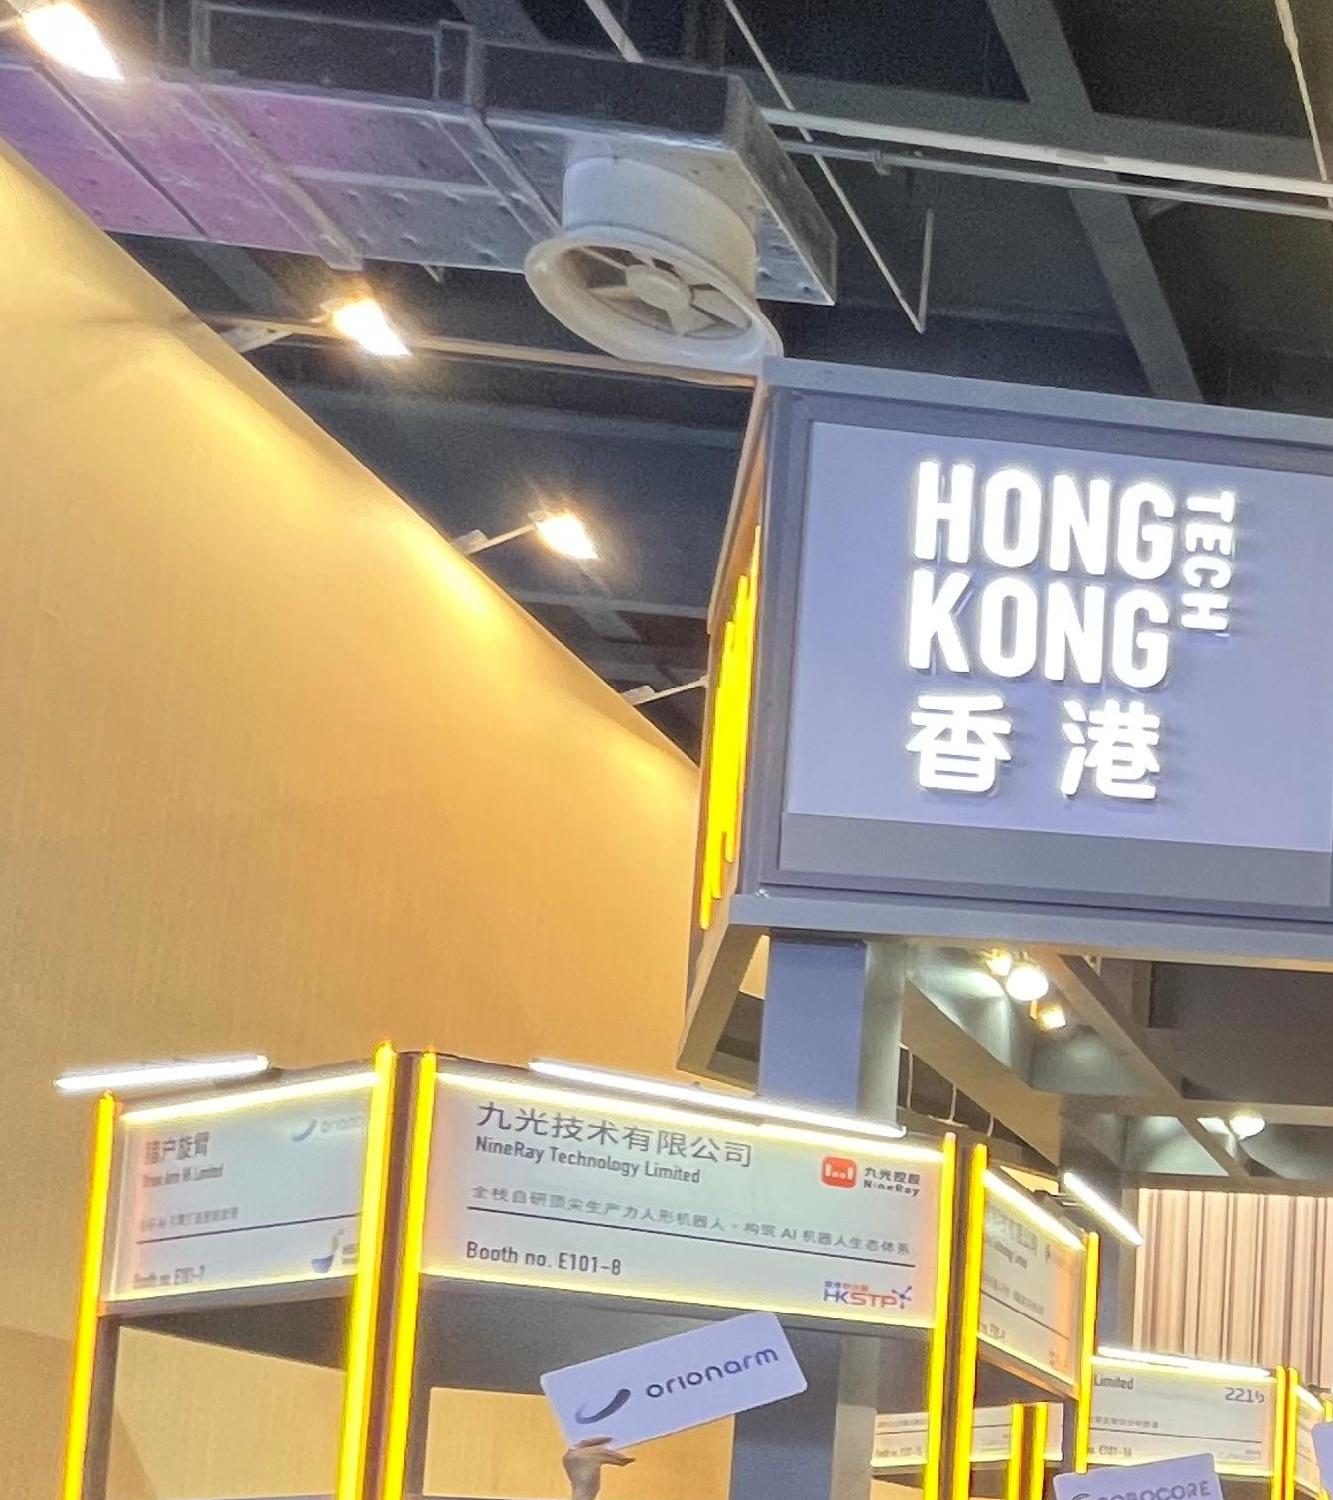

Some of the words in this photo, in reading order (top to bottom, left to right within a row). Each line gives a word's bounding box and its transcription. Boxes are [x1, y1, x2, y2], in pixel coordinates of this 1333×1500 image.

[913, 461, 1176, 580] HONG
[1180, 490, 1236, 634] TECH
[907, 568, 1171, 689] KONG
[907, 694, 1162, 801] 香港
[475, 1136, 545, 1164] NineRay
[549, 1146, 640, 1179] Technology
[645, 1160, 701, 1183] Limited
[476, 1101, 752, 1168] 九光技术有限公司
[863, 1181, 921, 1198] NineRay
[466, 1240, 518, 1264] Booth
[525, 1252, 552, 1269] no.
[558, 1252, 622, 1276] E101-8
[782, 1228, 798, 1241] AI
[823, 1287, 898, 1310] HKSTP
[646, 1348, 778, 1399] orionarm
